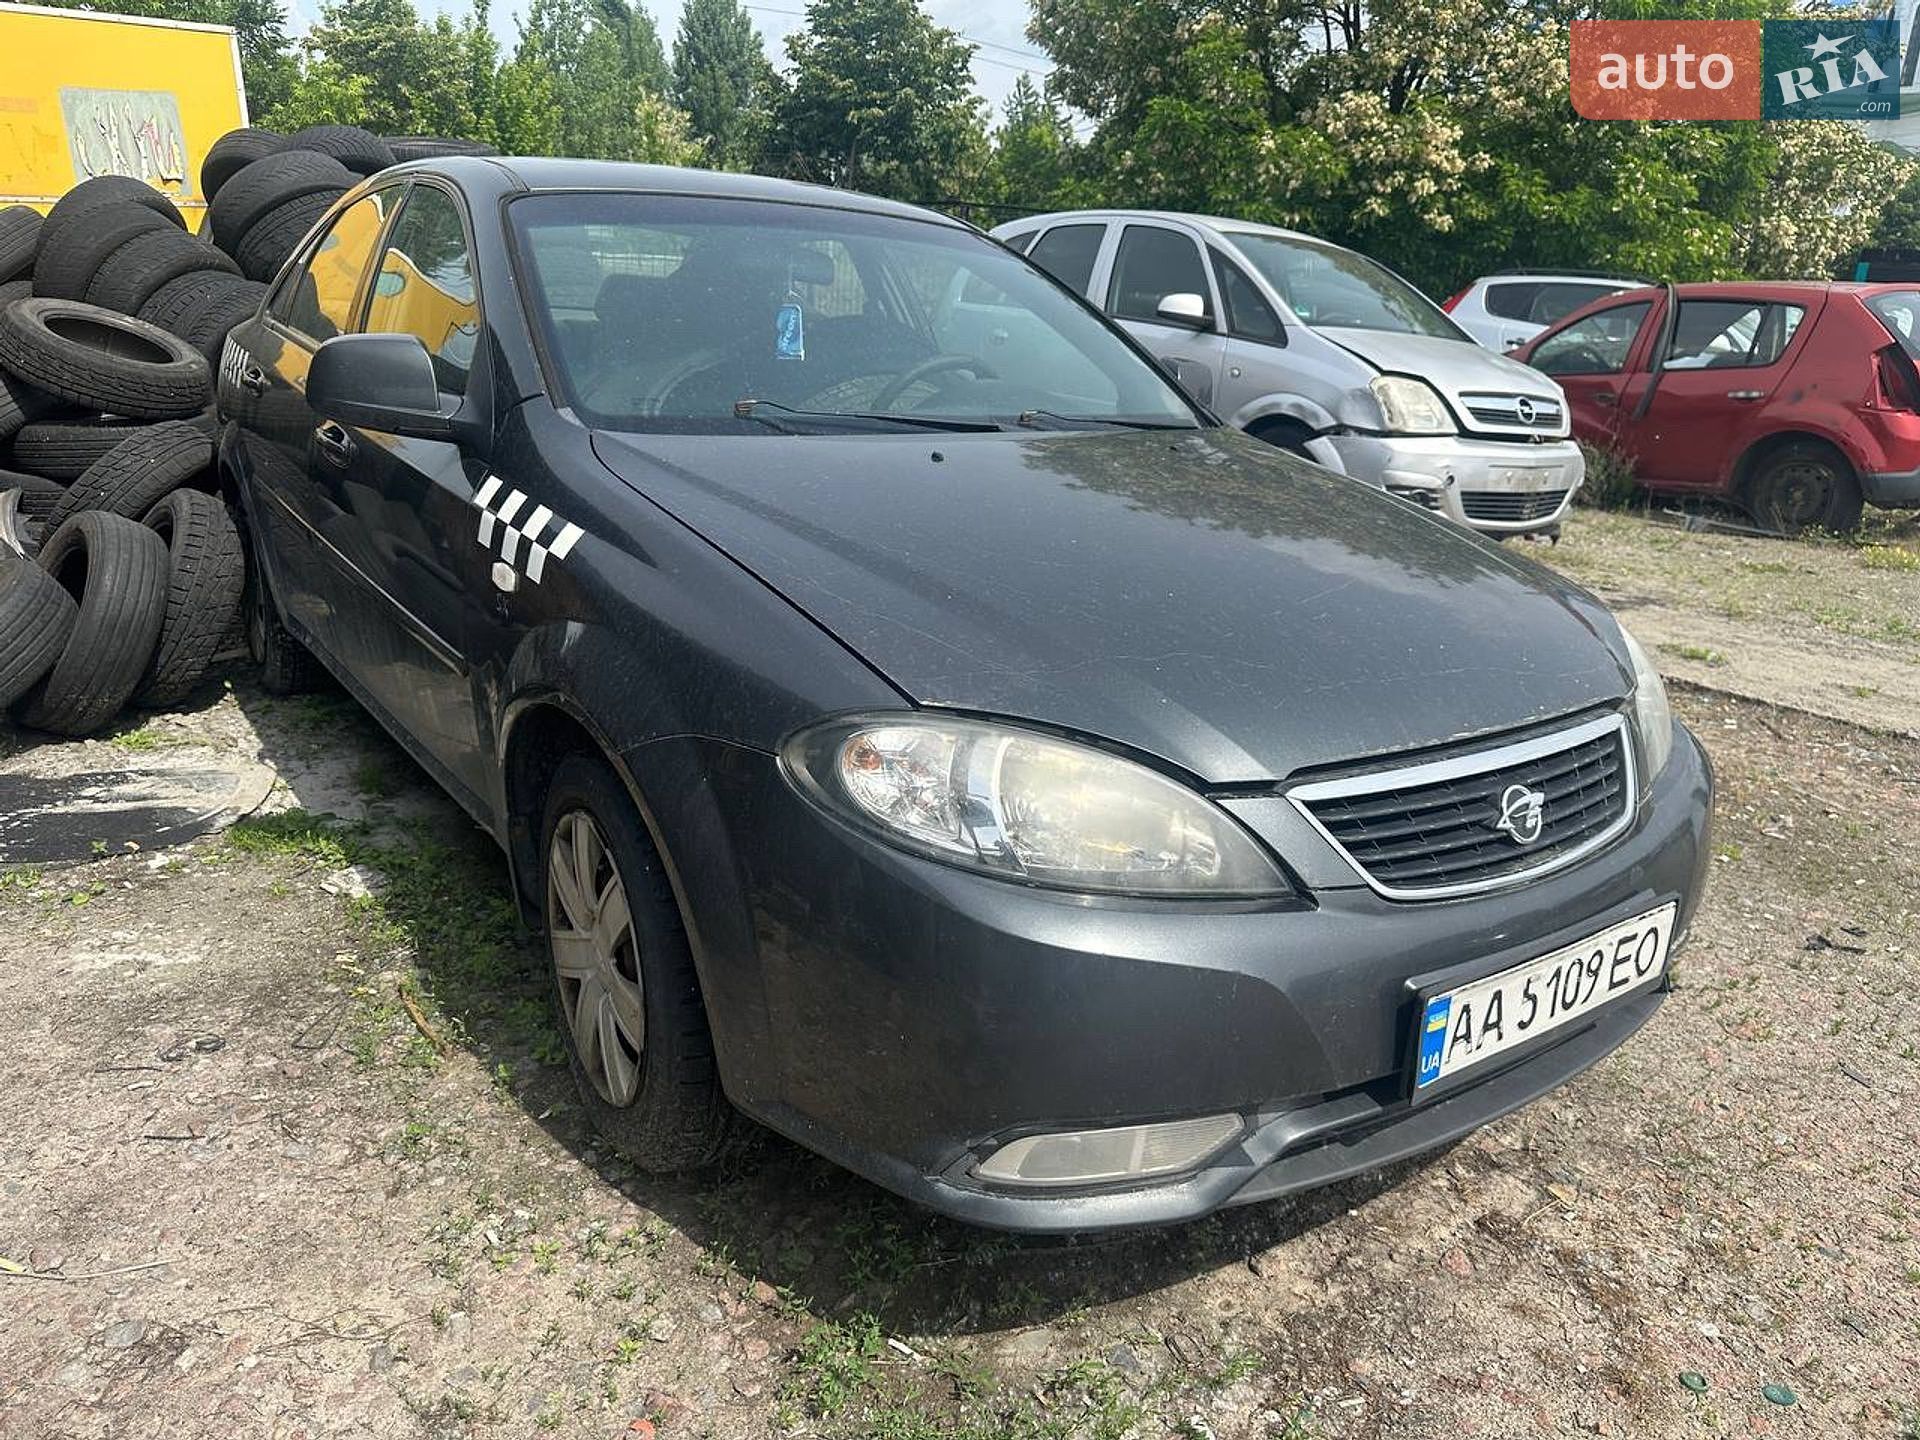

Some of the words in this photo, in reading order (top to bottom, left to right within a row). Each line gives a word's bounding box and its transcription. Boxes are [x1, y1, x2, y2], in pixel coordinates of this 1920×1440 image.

[1444, 989, 1503, 1064] AA
[1518, 950, 1603, 1030] 5109
[1609, 927, 1658, 991] EO
[1421, 1051, 1440, 1073] UA
